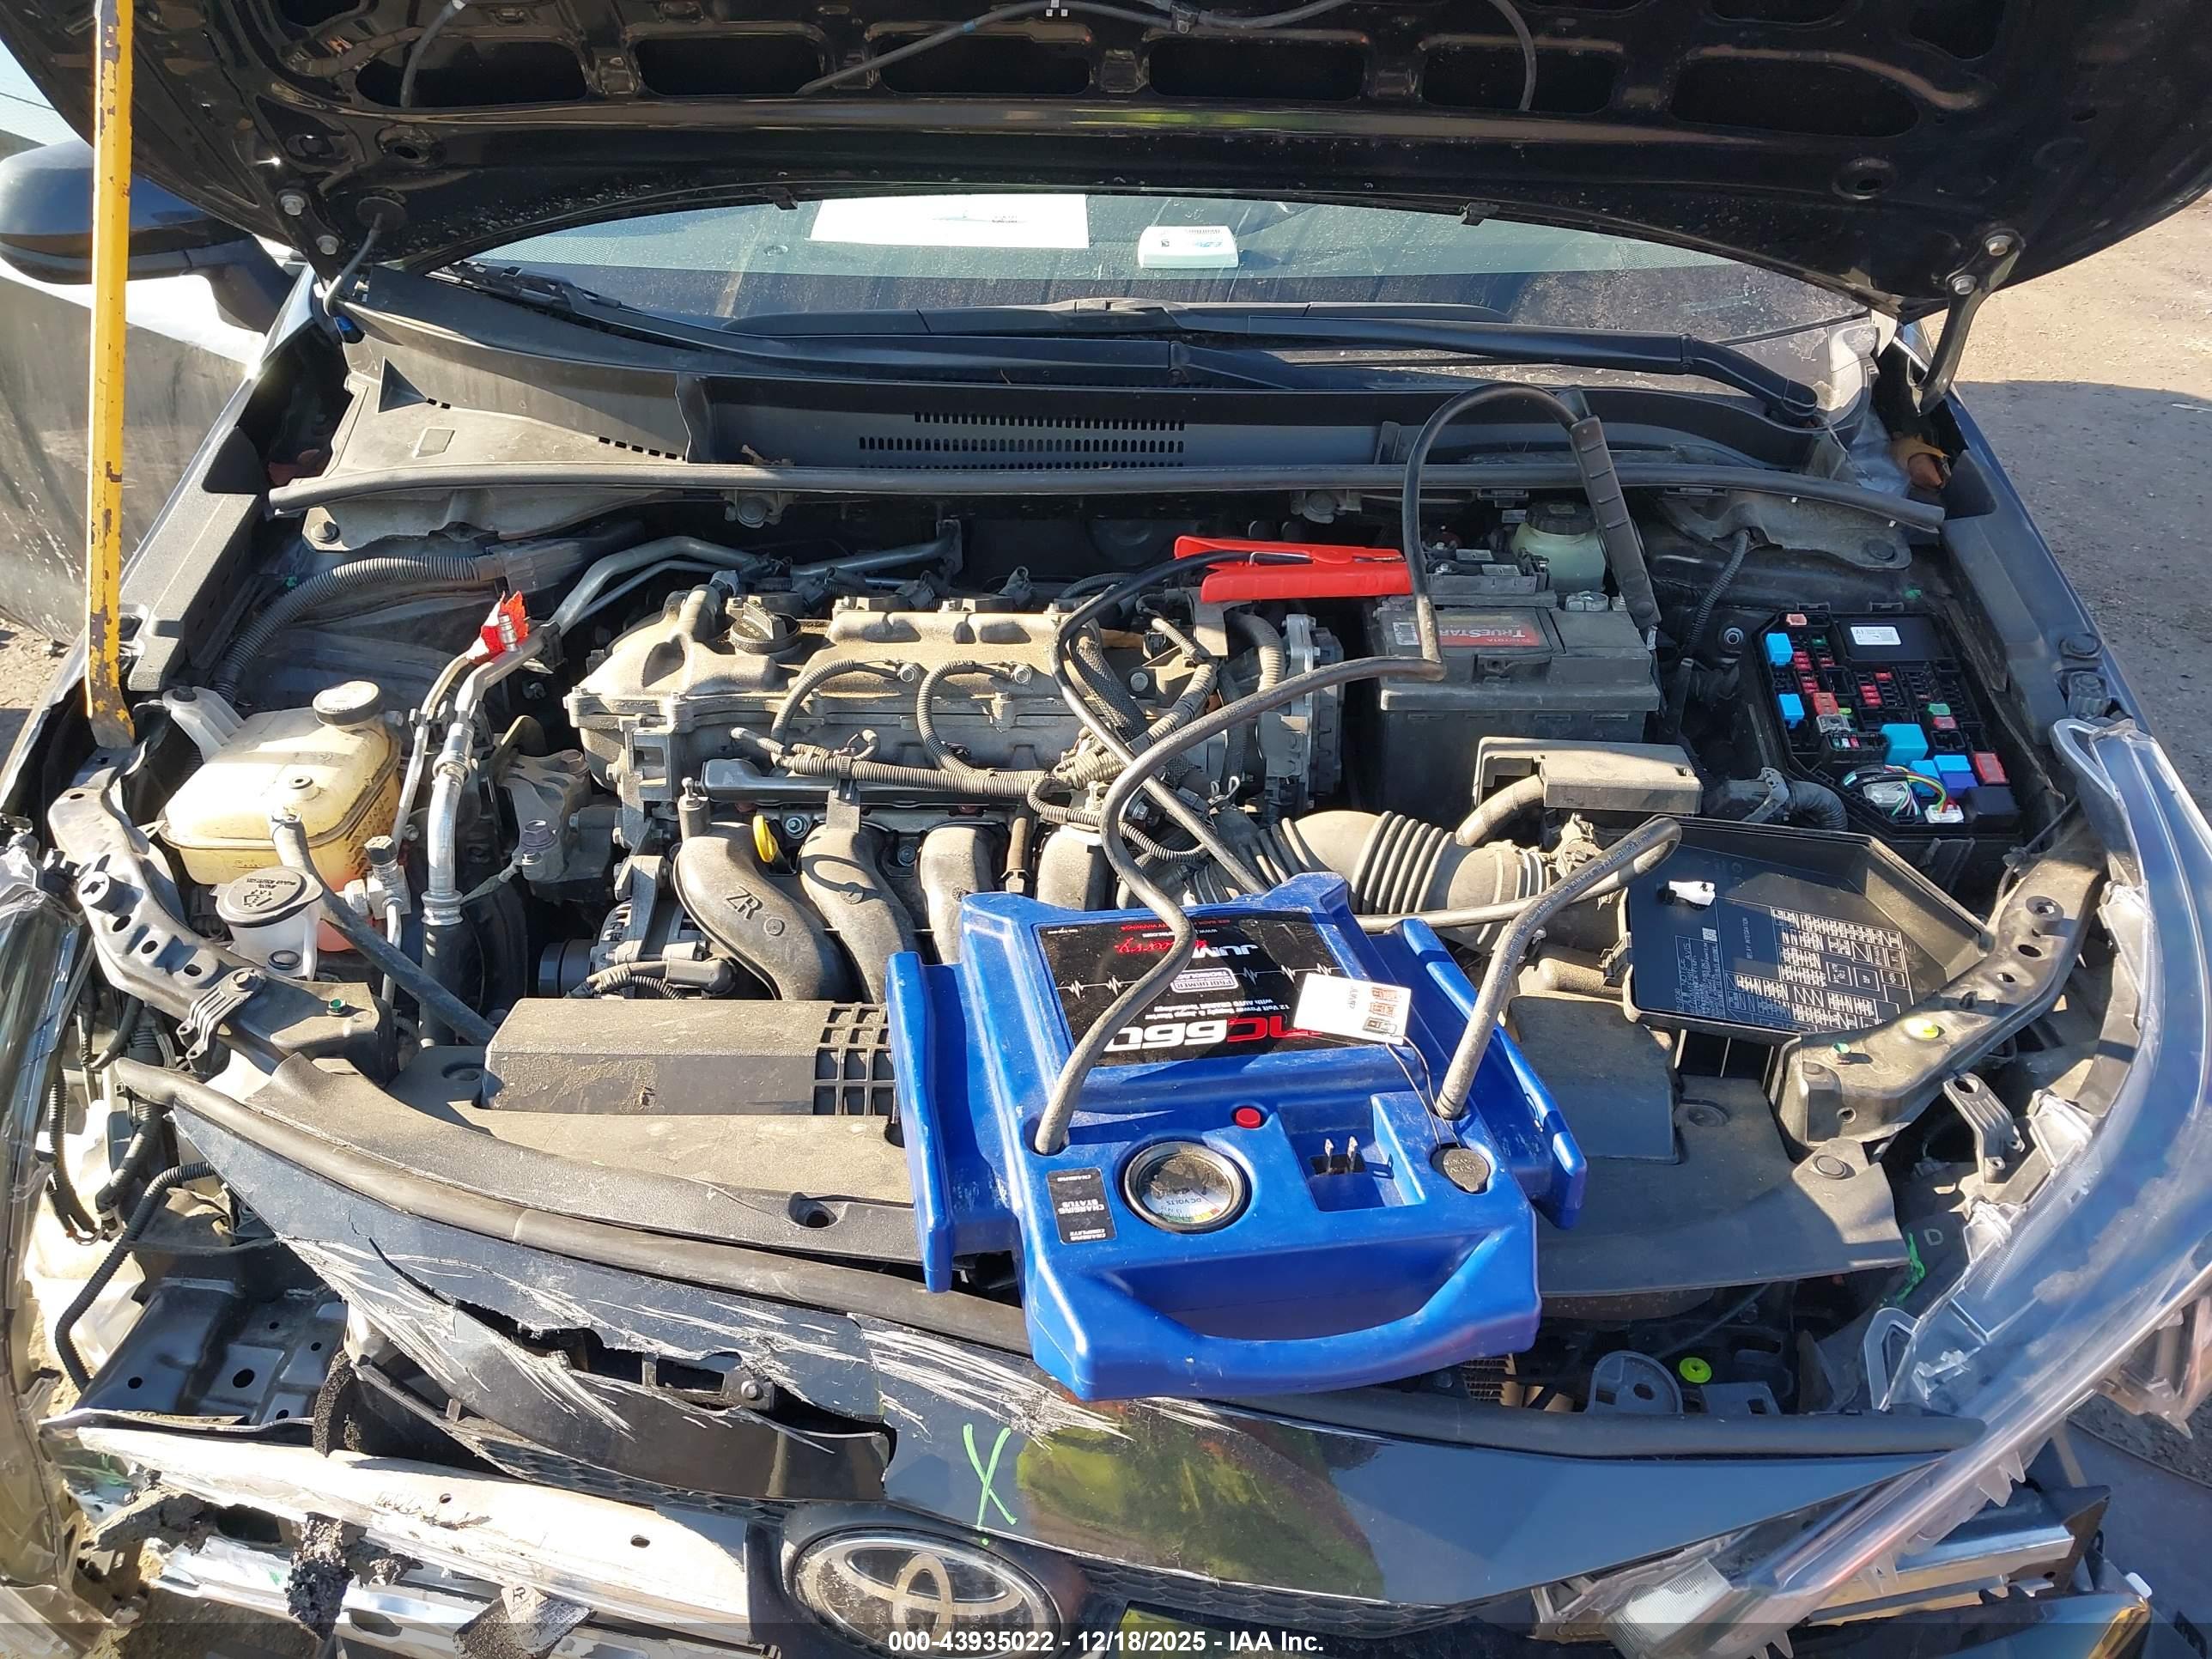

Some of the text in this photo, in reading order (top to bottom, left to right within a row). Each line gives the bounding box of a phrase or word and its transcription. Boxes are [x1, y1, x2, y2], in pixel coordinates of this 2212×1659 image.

[725, 885, 763, 921] ZR
[1117, 938, 1175, 955] arry
[1192, 945, 1259, 958] JUM
[1057, 1203, 1105, 1215] CHARGING
